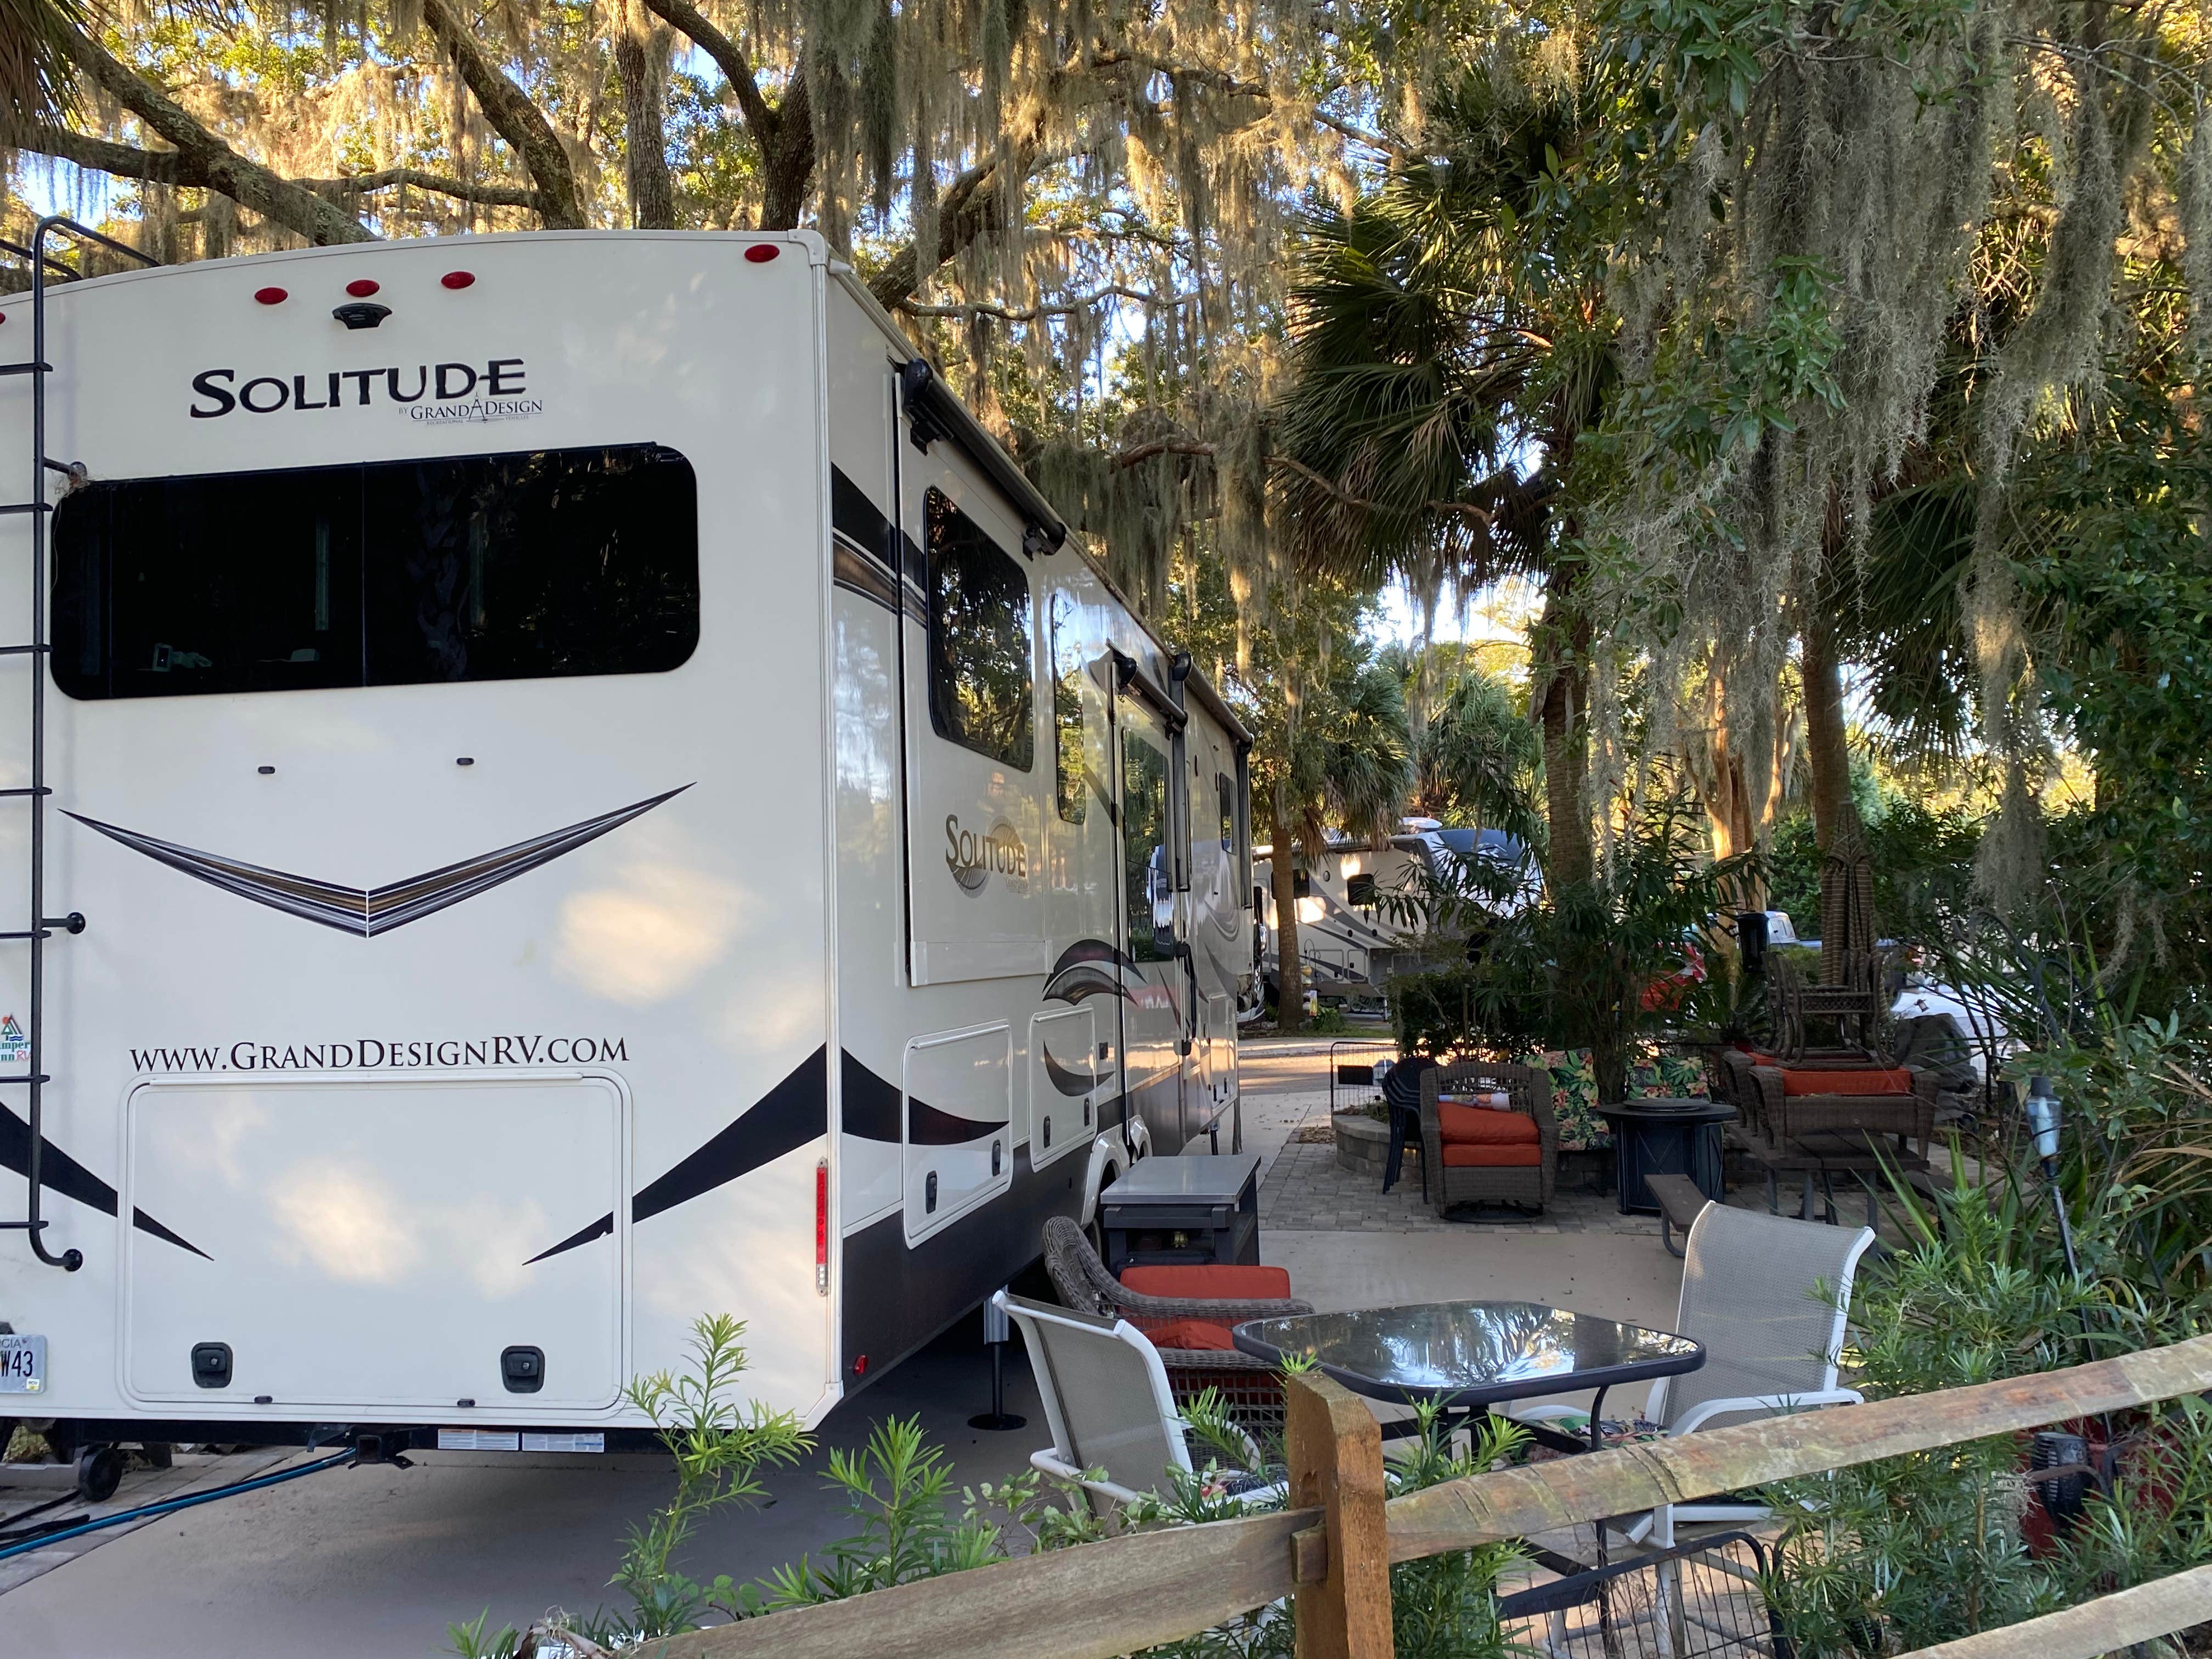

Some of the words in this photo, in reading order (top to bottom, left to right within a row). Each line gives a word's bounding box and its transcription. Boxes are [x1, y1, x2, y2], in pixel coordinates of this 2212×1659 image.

[190, 358, 526, 418] SOLITUDE
[398, 407, 409, 415] BY
[410, 404, 470, 420] GRAND
[485, 399, 543, 415] DESIGN
[946, 814, 1026, 878] SOLITUDE
[0, 1042, 30, 1052] mper
[0, 1338, 21, 1348] GIA
